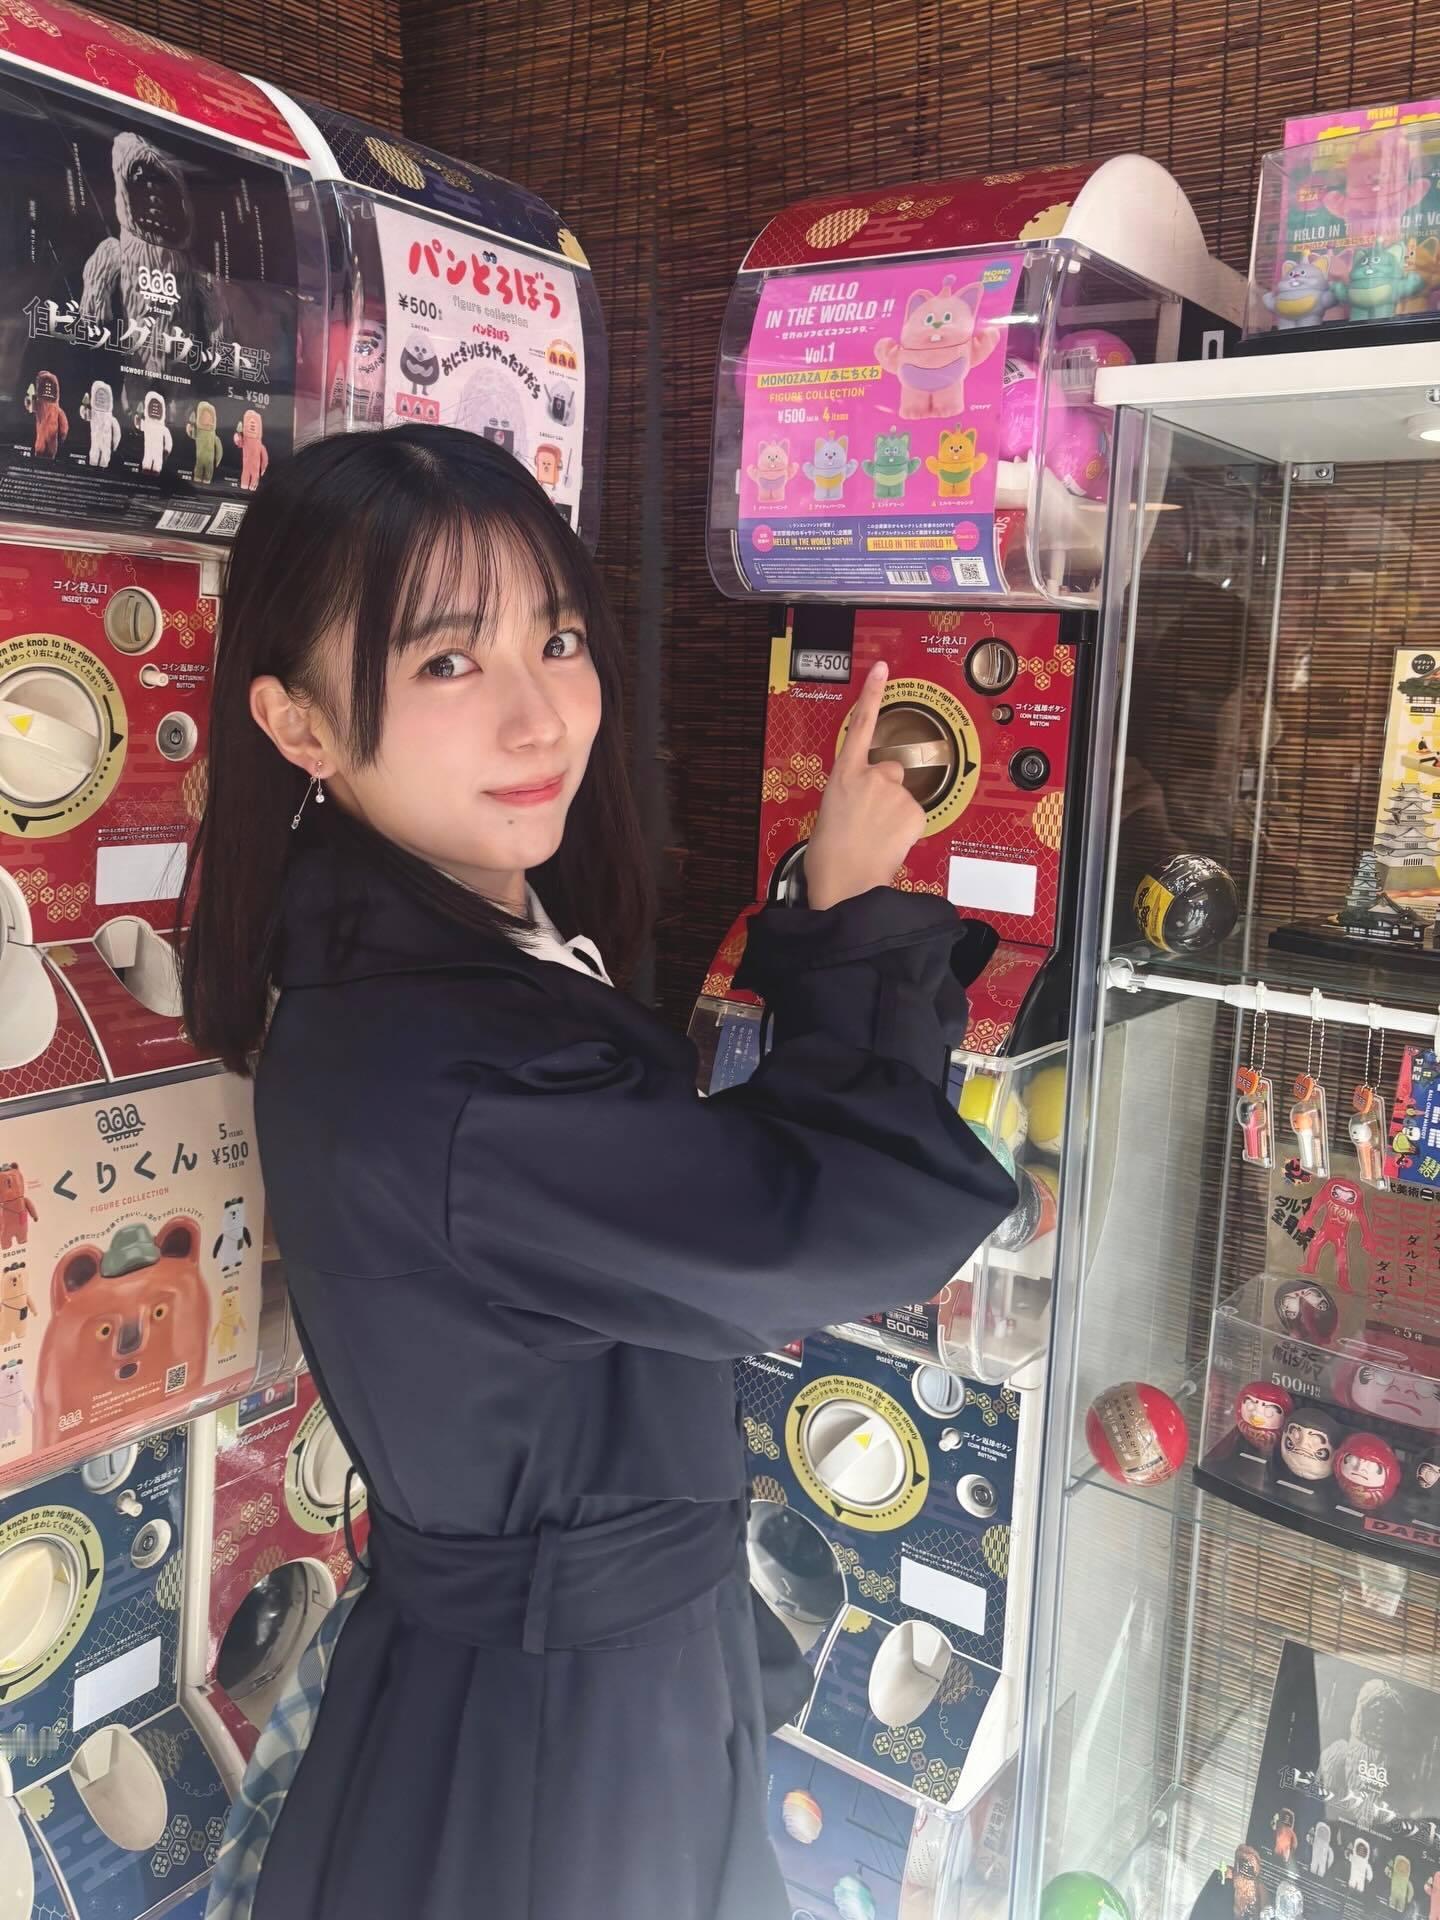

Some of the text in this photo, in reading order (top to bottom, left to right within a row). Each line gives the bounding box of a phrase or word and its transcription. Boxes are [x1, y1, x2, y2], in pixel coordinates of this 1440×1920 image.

[1294, 225, 1325, 242] HELLO
[408, 238, 562, 319] パンどろぼう
[809, 282, 859, 303] HELLO
[398, 293, 437, 320] ¥500
[765, 310, 783, 329] IN
[787, 306, 817, 327] THE
[820, 300, 878, 324] WORLD
[472, 323, 510, 342] パンどろぼう
[805, 342, 836, 365] Vol.1
[441, 340, 541, 400] おにぎりぼうやのたびだち
[760, 374, 821, 387] MOMOZAZA
[247, 389, 270, 406] ¥500
[769, 386, 865, 404] FIGURE COLLECTION
[778, 408, 806, 424] ¥500
[822, 407, 830, 421] 4
[873, 540, 893, 549] HELLO
[895, 540, 902, 549] IN
[904, 540, 918, 549] THE
[920, 539, 944, 549] WORLD
[53, 580, 108, 594] コイン投入口
[61, 595, 99, 605] INSERT COIN
[920, 636, 967, 645] コイン投入口
[9, 638, 115, 692] the knob to the right slowly
[815, 655, 850, 671] ¥500
[790, 687, 843, 702] Kenelephant
[926, 685, 938, 695] the
[938, 690, 955, 706] right
[953, 703, 970, 727] slowly
[1016, 703, 1067, 713] コイン返却ボタン
[1030, 720, 1049, 728] BUTTON
[95, 1104, 146, 1135] aaa
[218, 1123, 227, 1140] 5
[212, 1141, 249, 1166] ¥500
[53, 1142, 198, 1201] くりくん
[90, 1187, 169, 1215] FIGURE COLLECTION
[742, 1355, 794, 1381] Kenelephant
[876, 1354, 893, 1364] INSERT
[819, 1379, 832, 1388] turn
[833, 1378, 845, 1386] the
[846, 1379, 864, 1390] knob
[866, 1385, 874, 1394] to
[875, 1389, 887, 1402] the
[887, 1399, 903, 1416] right
[902, 1416, 918, 1441] slowly
[977, 1451, 997, 1462] BUTTON
[7, 1509, 91, 1536] knob to the right slowly
